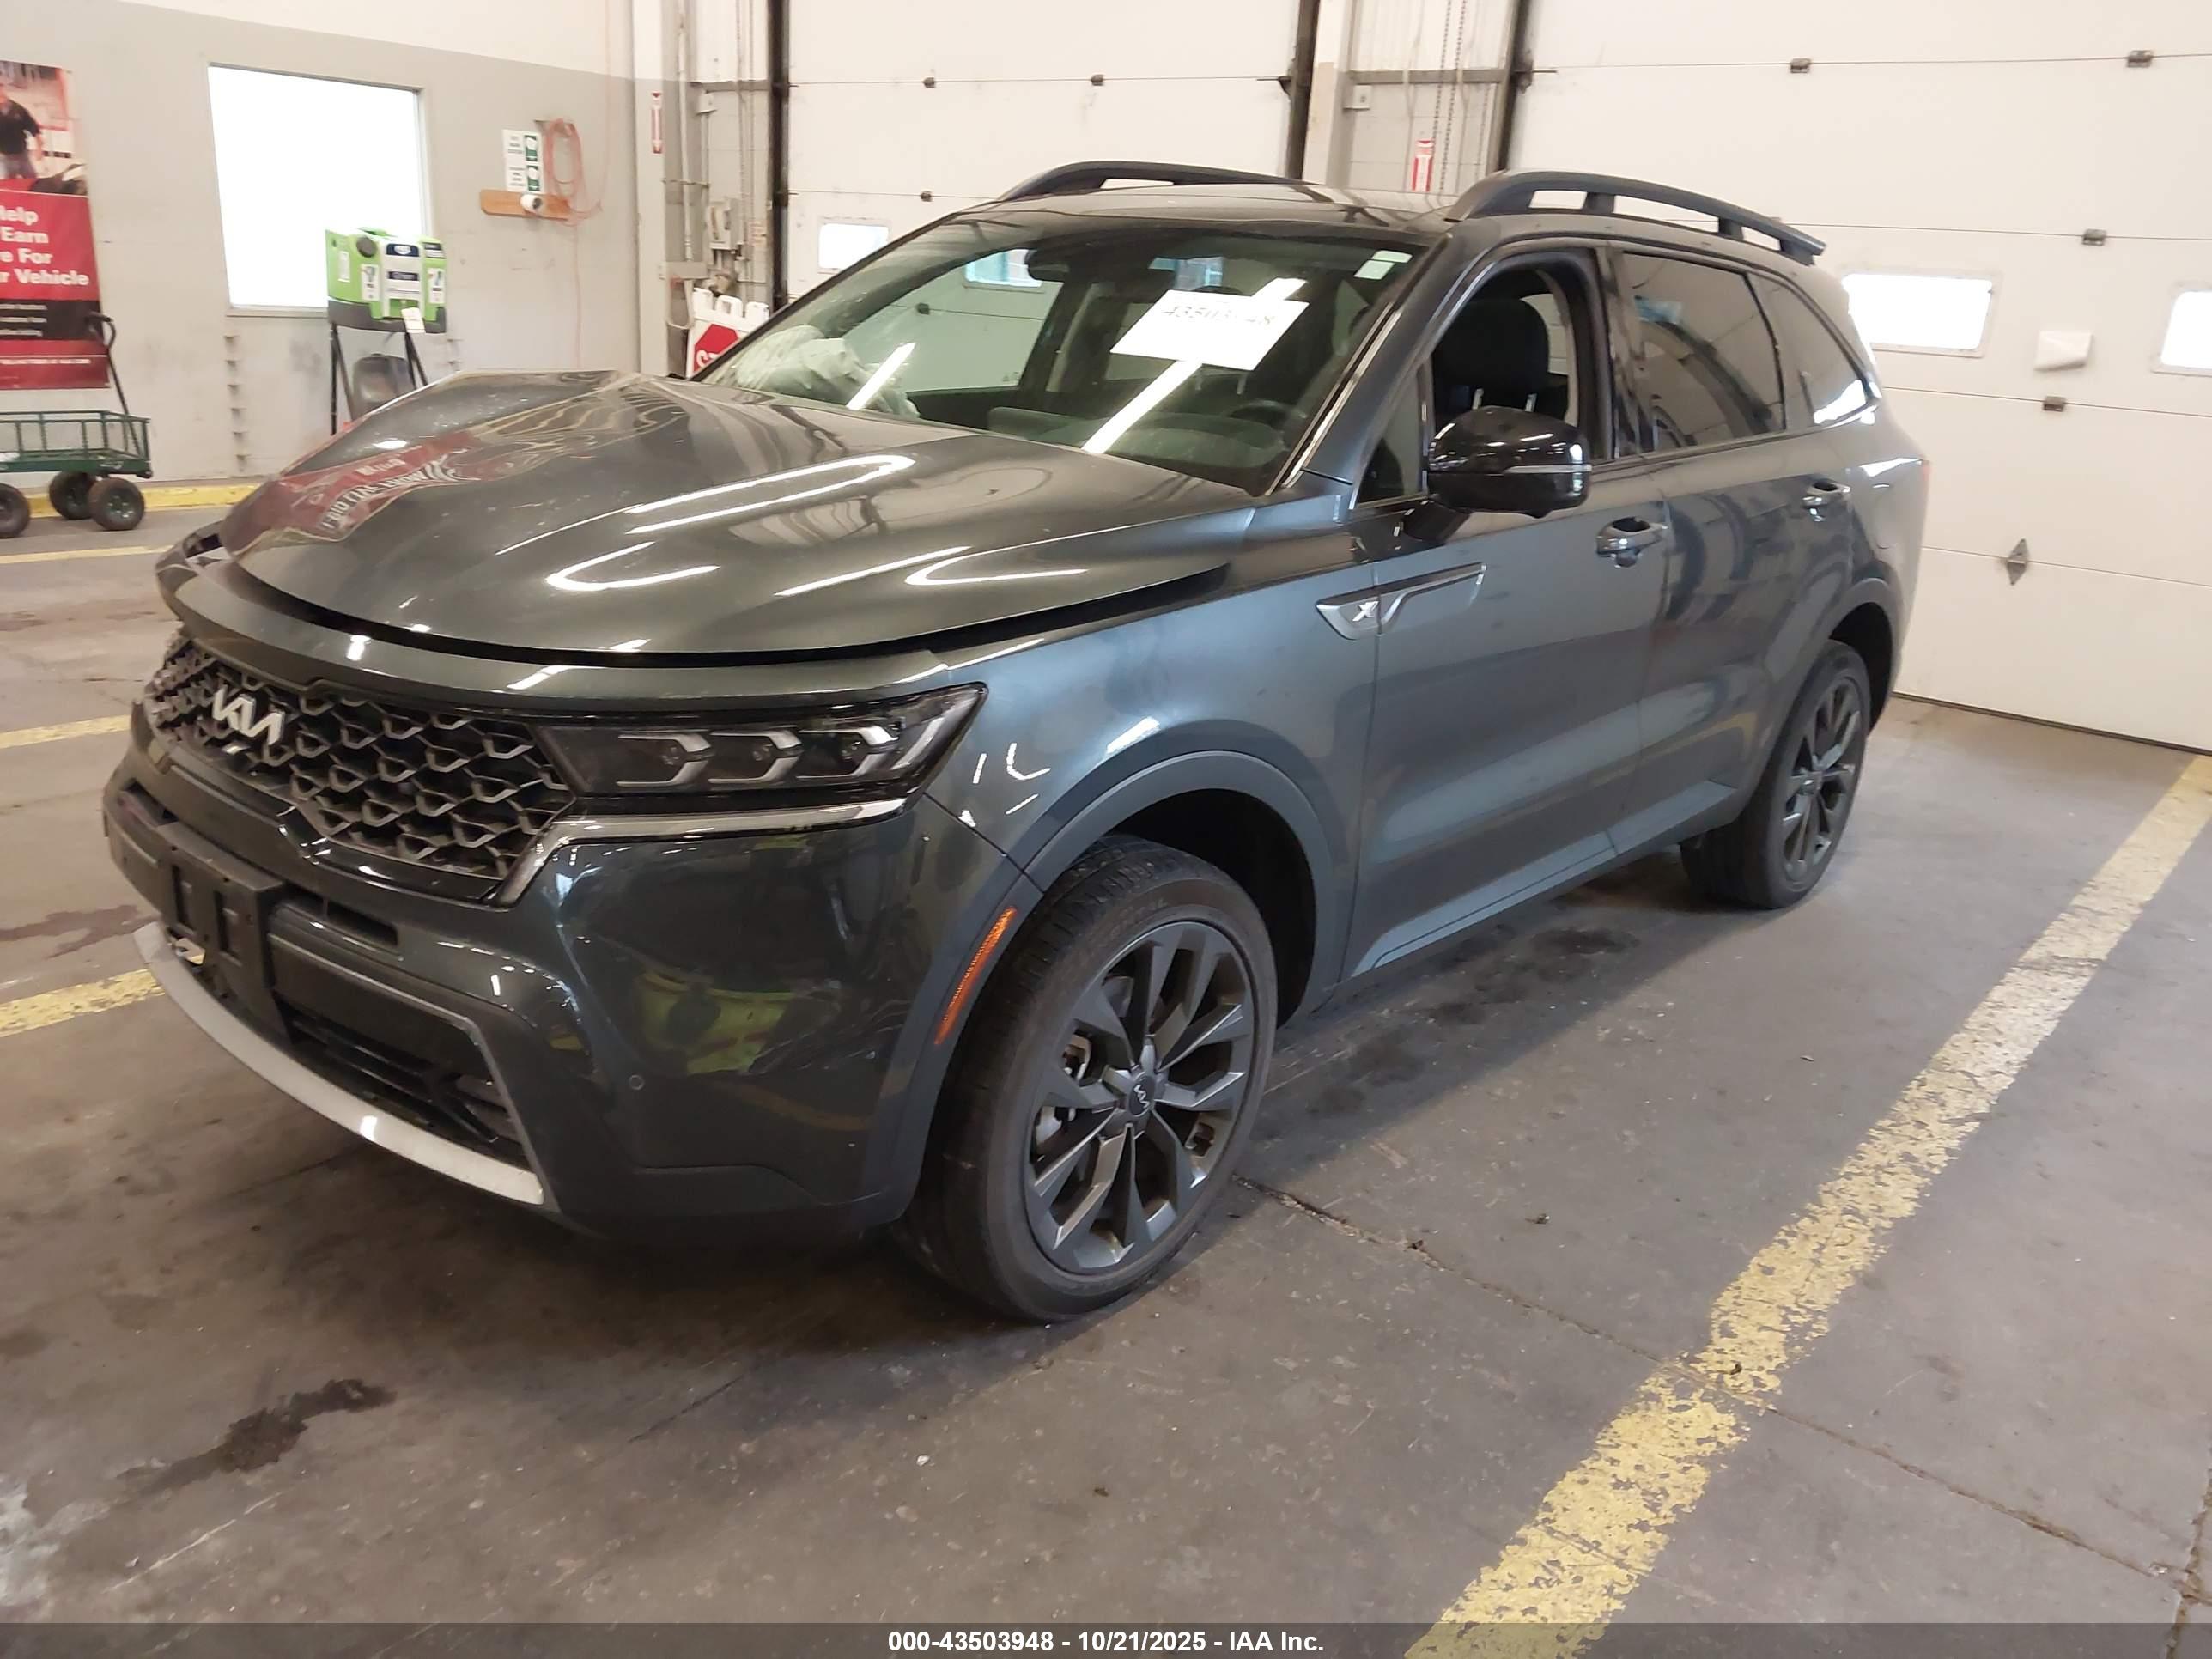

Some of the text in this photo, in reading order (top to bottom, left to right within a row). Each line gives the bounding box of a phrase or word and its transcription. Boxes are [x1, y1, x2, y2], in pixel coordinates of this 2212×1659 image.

[1, 226, 49, 243] Earn
[18, 247, 52, 264] For
[14, 268, 89, 285] Vehicle
[212, 684, 285, 746] KIA
